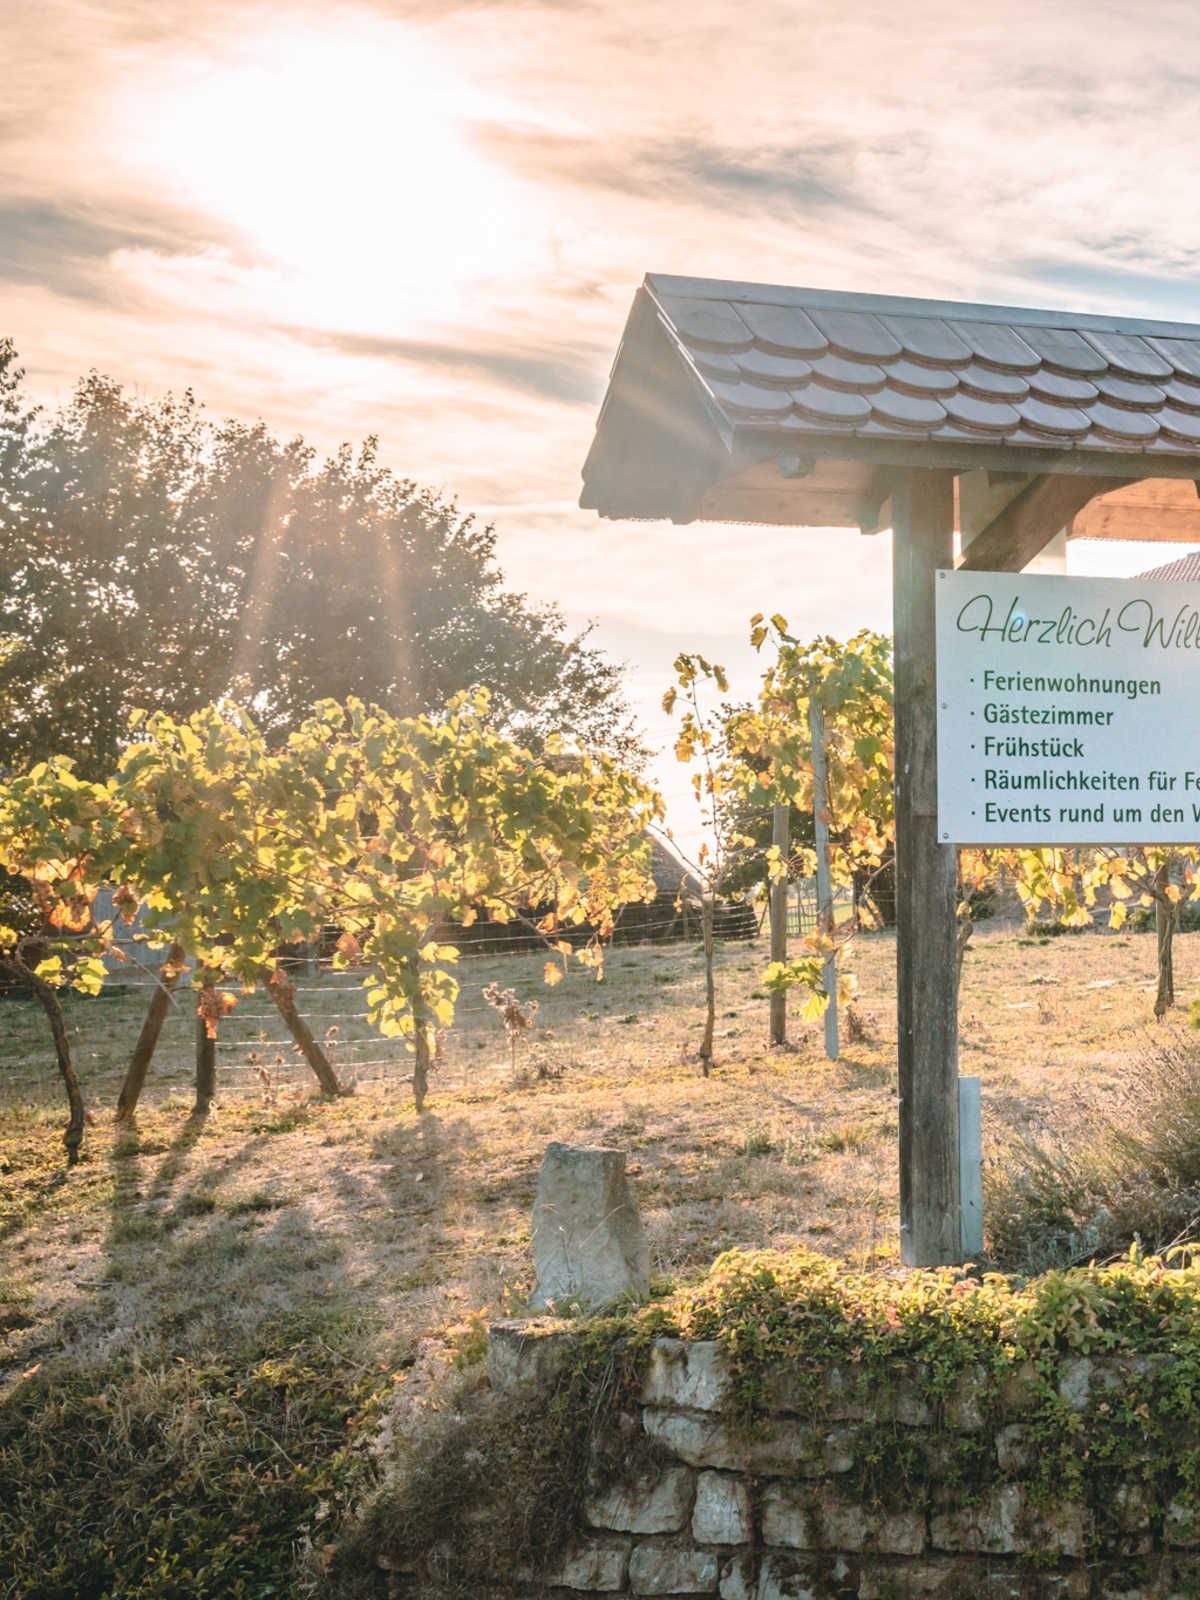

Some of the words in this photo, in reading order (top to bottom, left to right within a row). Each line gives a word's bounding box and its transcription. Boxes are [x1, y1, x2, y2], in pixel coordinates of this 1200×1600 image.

[956, 594, 1112, 648] Herzlich
[983, 670, 1162, 699] Ferienwohnungen
[983, 703, 1115, 726] Gästezimmer
[984, 736, 1085, 758] Frühstück
[984, 769, 1140, 791] Räumlichkeiten
[1147, 772, 1177, 792] für
[985, 802, 1052, 823] Events
[1059, 803, 1104, 824] rund
[1112, 808, 1143, 824] um
[1150, 805, 1185, 824] den
